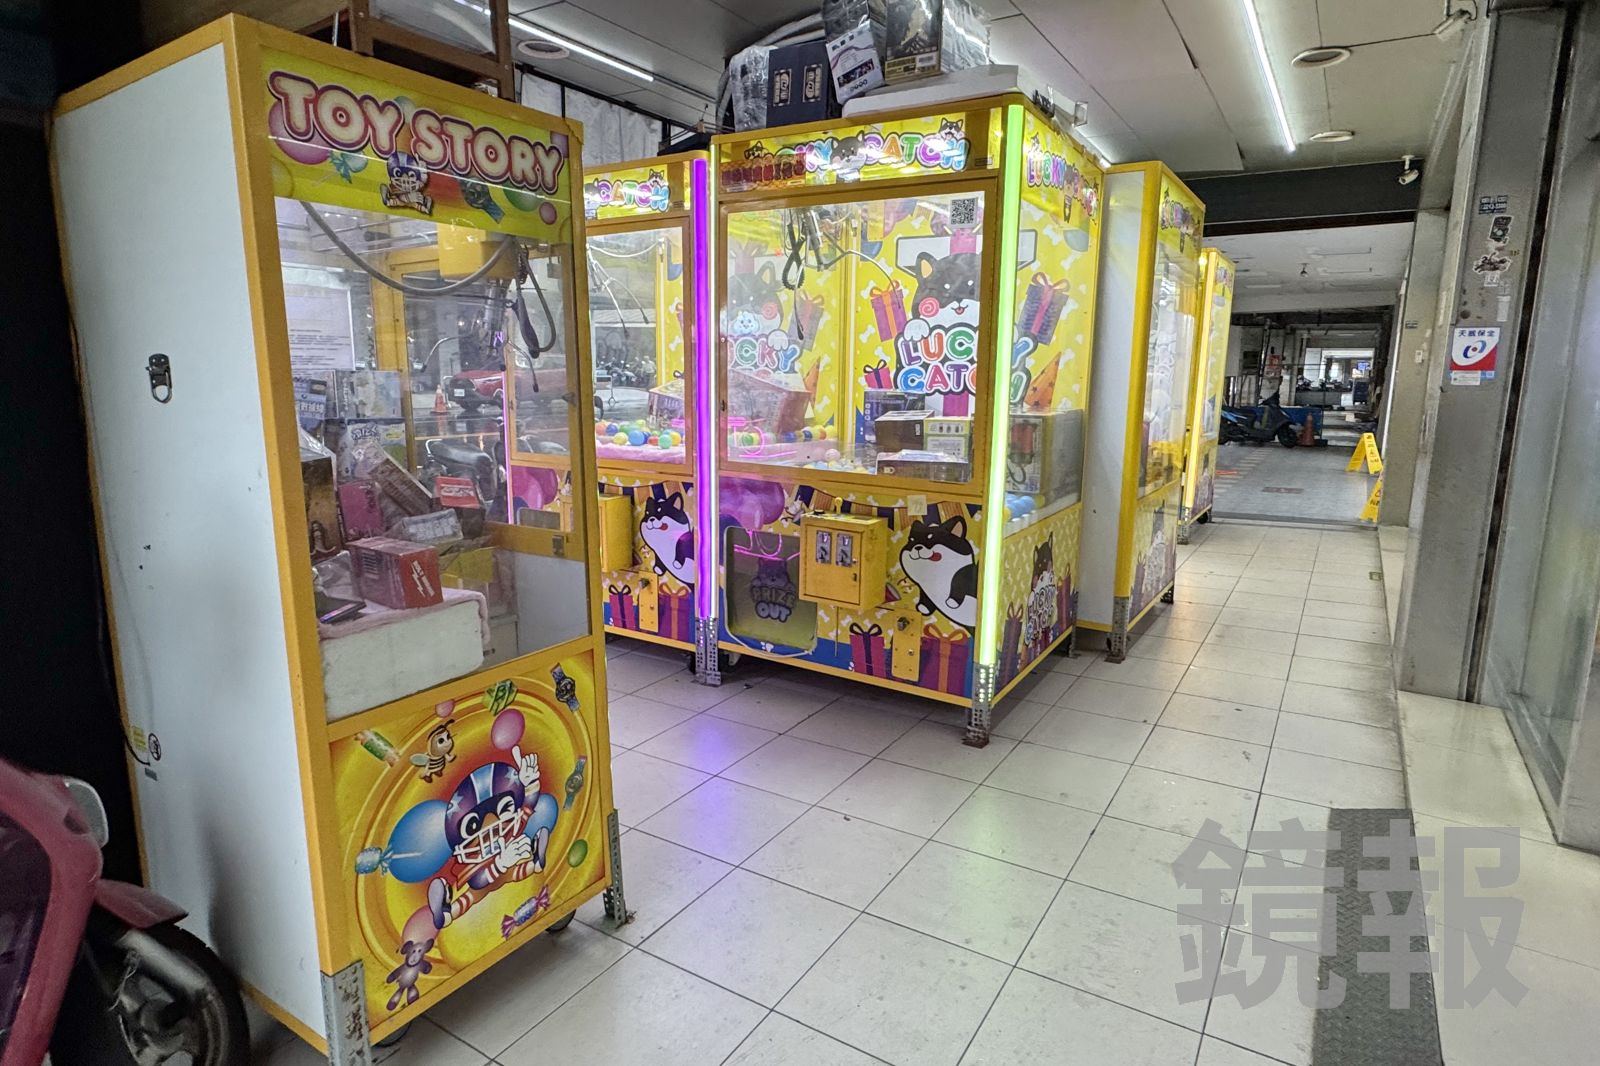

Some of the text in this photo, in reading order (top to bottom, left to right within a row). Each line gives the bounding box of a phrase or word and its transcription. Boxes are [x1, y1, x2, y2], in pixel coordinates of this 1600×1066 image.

[267, 70, 564, 194] TOY STORY
[862, 131, 969, 172] CATCH
[598, 180, 671, 211] CATCH
[751, 586, 796, 609] PRIZE
[756, 600, 792, 622] OUT
